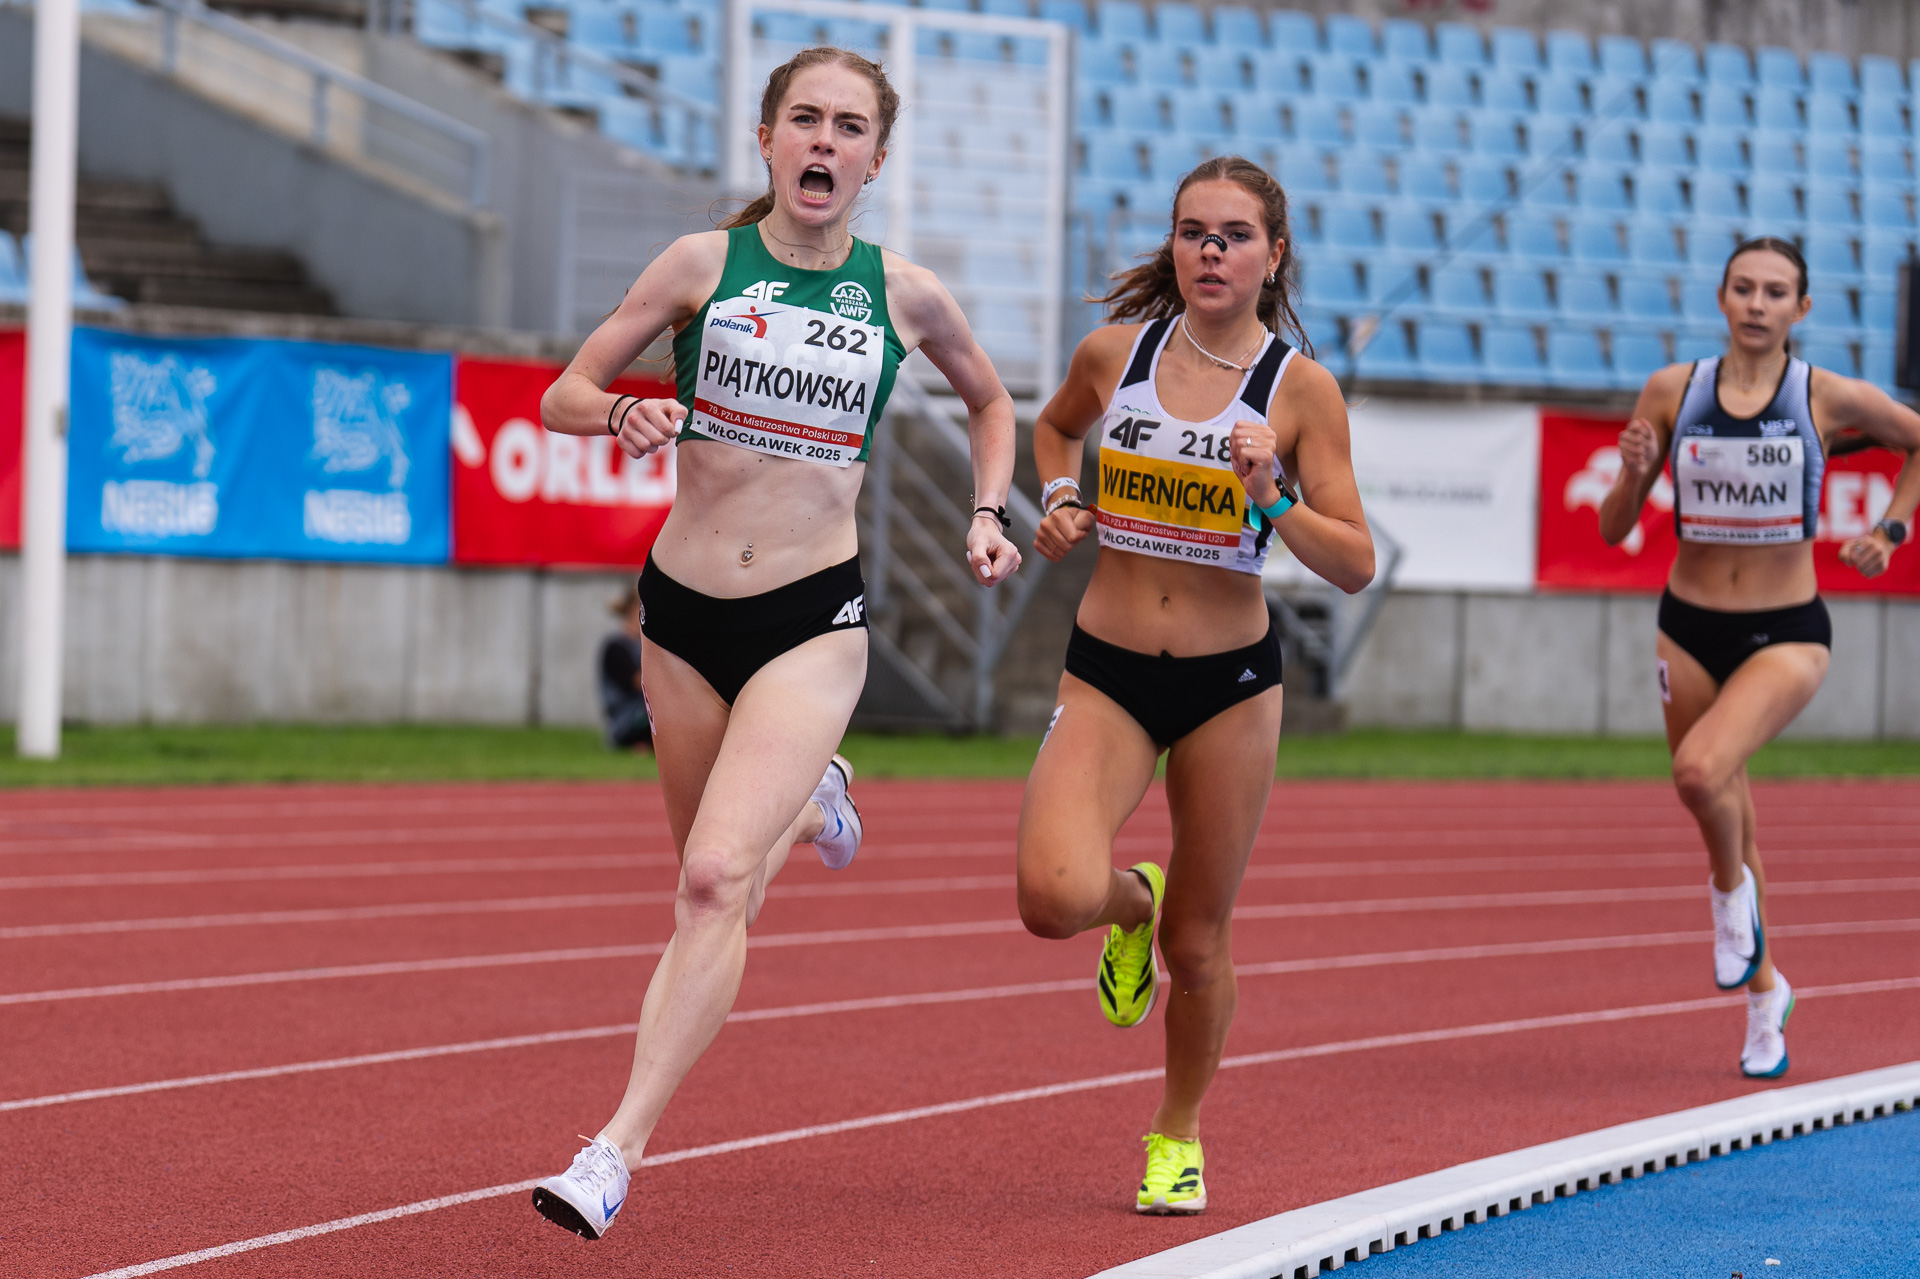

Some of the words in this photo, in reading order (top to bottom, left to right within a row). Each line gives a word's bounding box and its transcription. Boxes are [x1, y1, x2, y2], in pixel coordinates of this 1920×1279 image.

[835, 297, 868, 308] WARSZAWA
[840, 287, 864, 302] AZS
[709, 317, 755, 334] polanik
[838, 303, 866, 318] AWF
[804, 319, 868, 356] 262
[703, 350, 866, 415] PIĄTKOWSKA
[707, 403, 720, 416] 79.
[720, 409, 742, 424] PZLA
[743, 417, 801, 435] Mistrzostwa
[802, 427, 830, 441] Polski
[831, 432, 848, 443] U20
[1109, 416, 1162, 450] 4F
[707, 420, 804, 456] WŁOCŁAWEK
[806, 445, 841, 461] 2025
[1178, 429, 1231, 463] 218
[1747, 444, 1791, 466] 580
[488, 417, 677, 506] ORLE
[1103, 463, 1237, 517] WIERNICKA
[1691, 479, 1787, 505] TYMAN
[1103, 530, 1183, 556] WŁOCŁAWEK
[1185, 546, 1220, 561] 2025
[1112, 516, 1129, 529] PZLA
[1129, 521, 1180, 538] Mistrzostwa
[1180, 530, 1207, 543] Polski
[1207, 534, 1226, 545] U20
[832, 594, 864, 625] 4F
